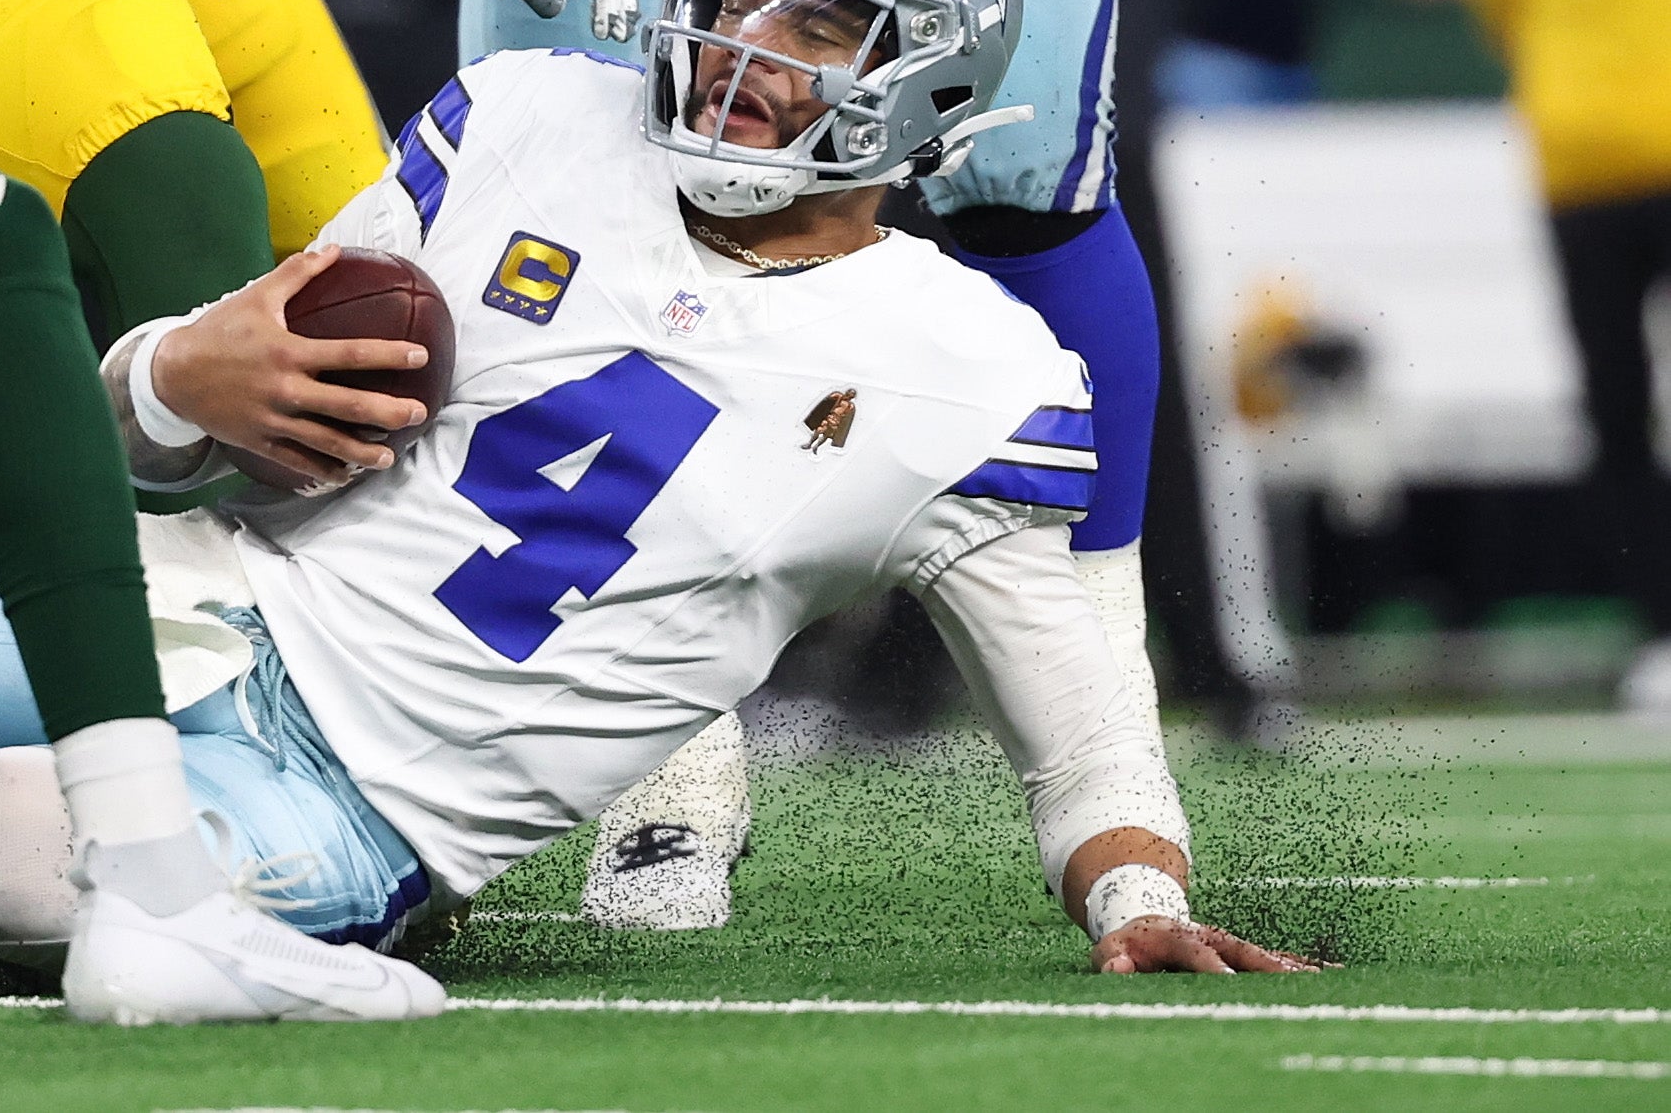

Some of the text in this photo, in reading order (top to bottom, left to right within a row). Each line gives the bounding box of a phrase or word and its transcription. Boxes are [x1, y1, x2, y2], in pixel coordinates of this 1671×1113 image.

[498, 238, 571, 302] C
[666, 302, 696, 331] NFL
[435, 349, 721, 665] 4
